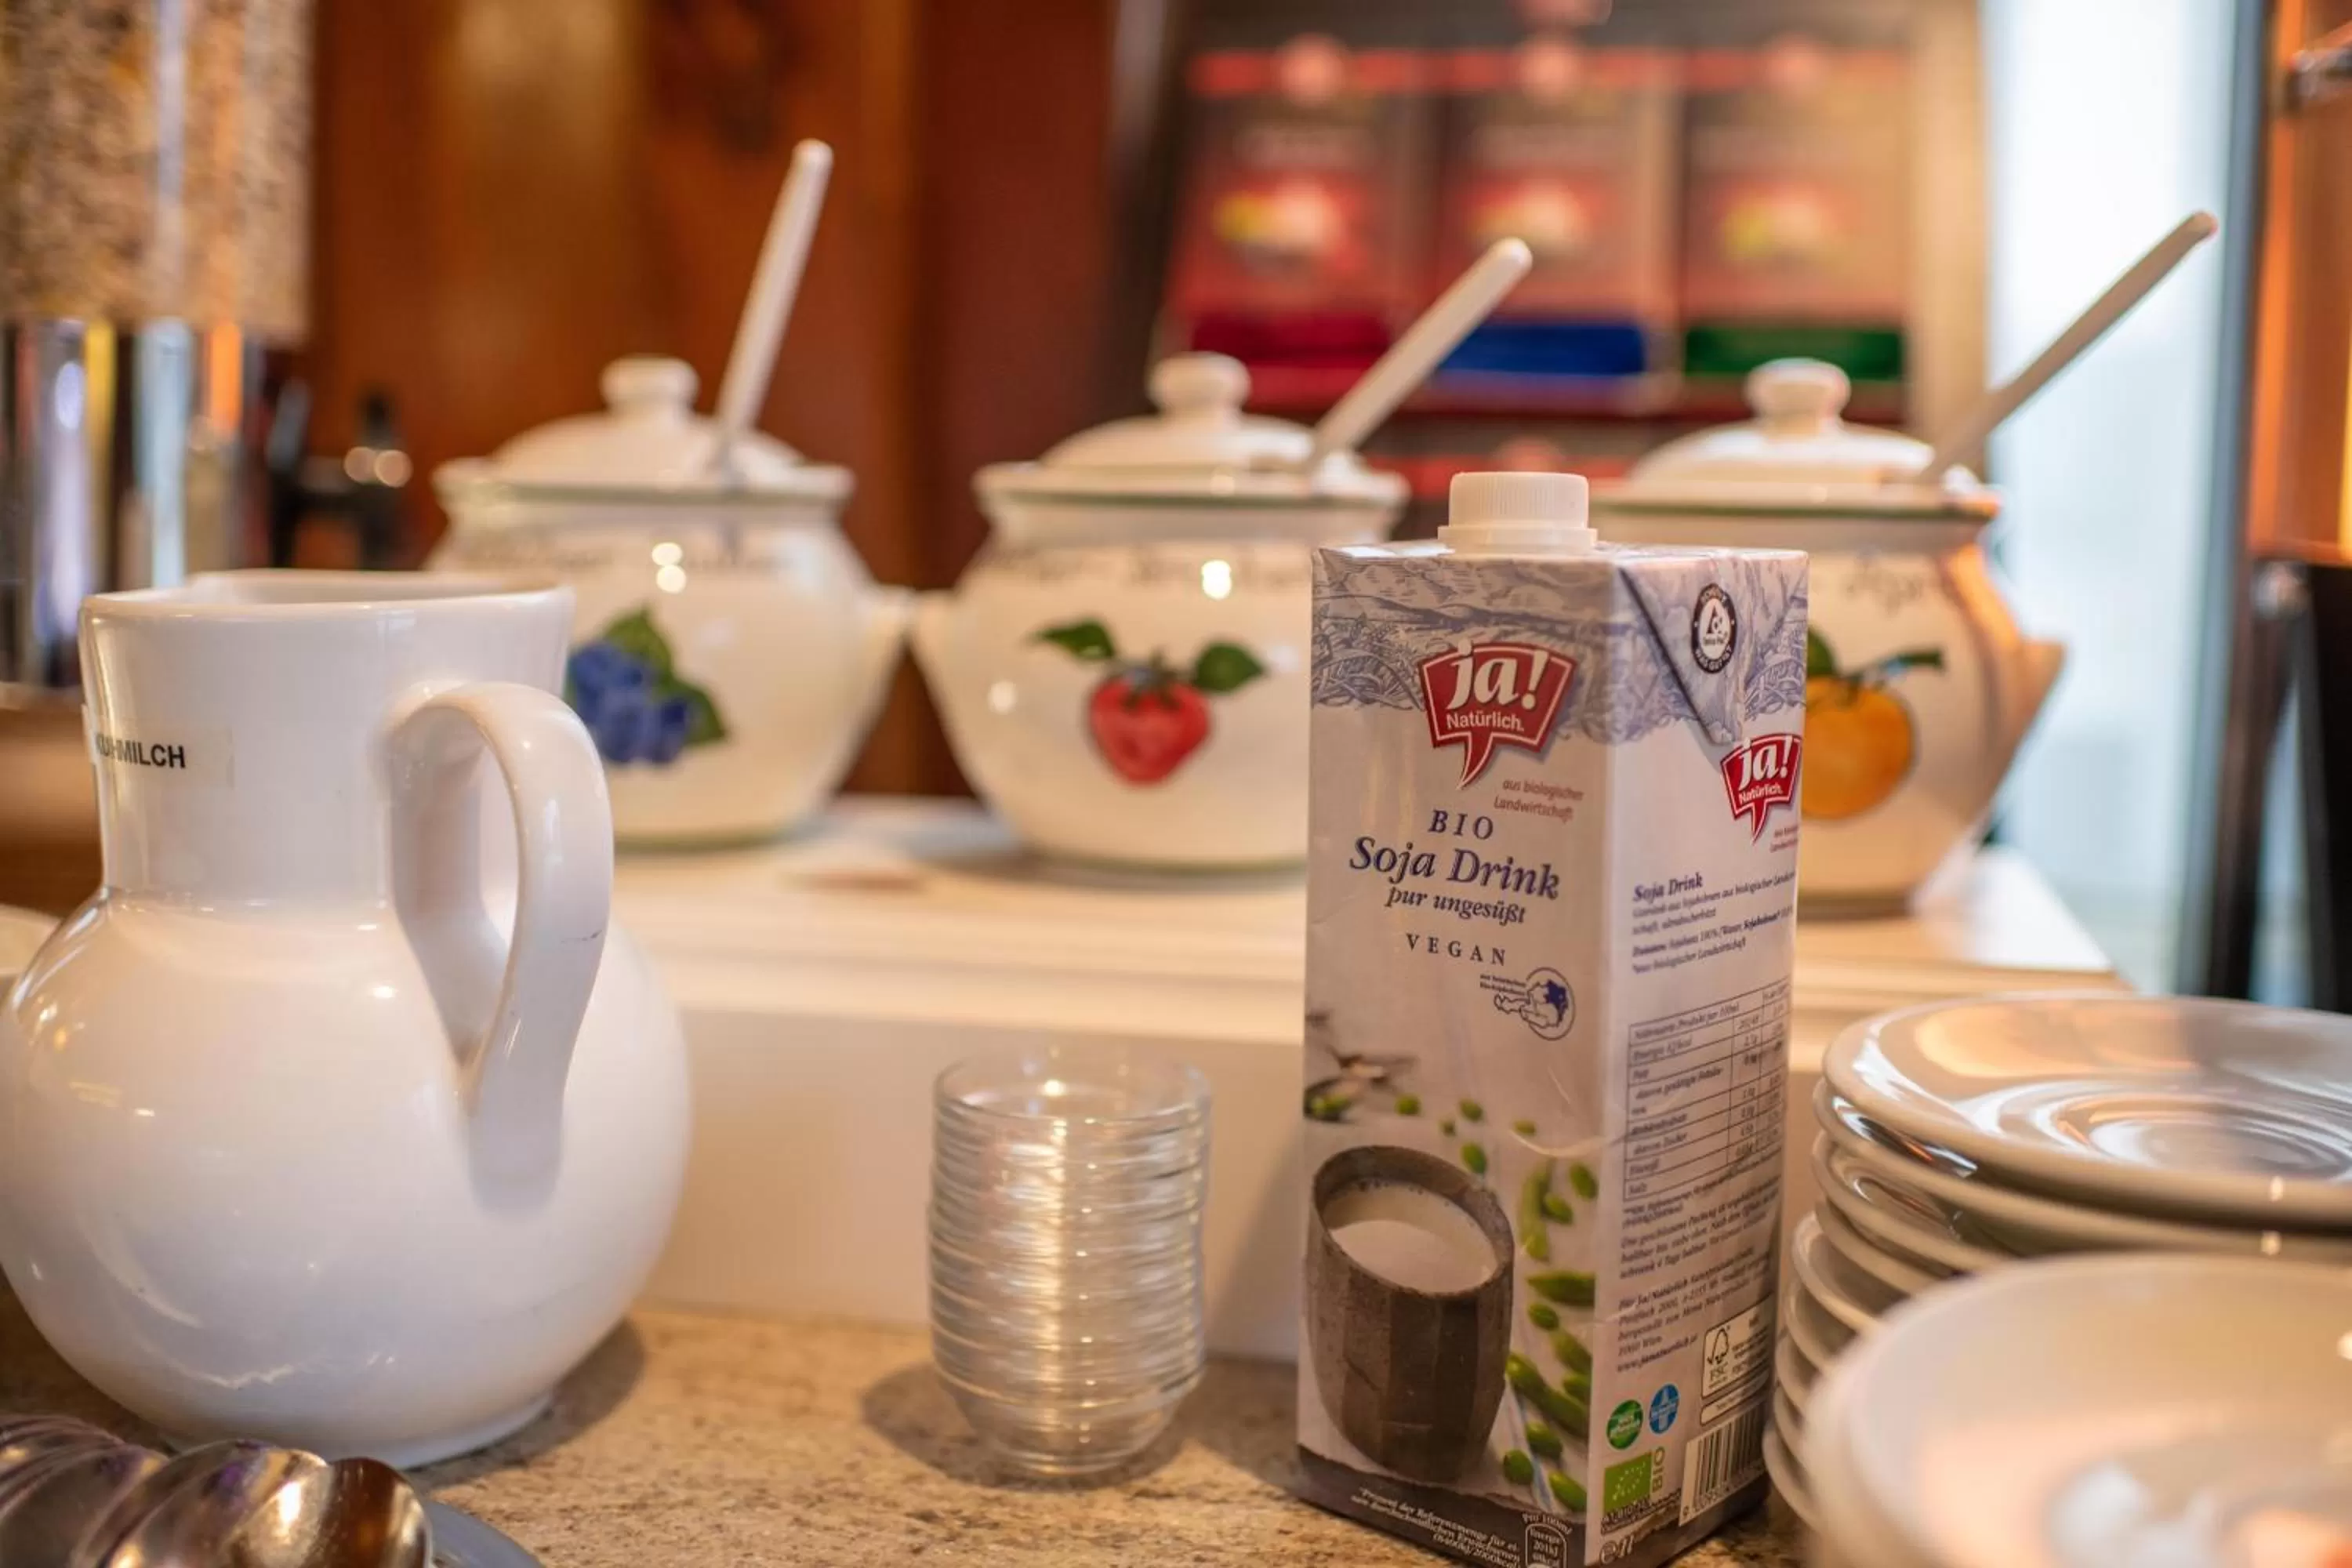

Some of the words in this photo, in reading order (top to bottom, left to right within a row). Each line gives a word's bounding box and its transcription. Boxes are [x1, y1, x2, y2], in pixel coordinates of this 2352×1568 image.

[1445, 638, 1550, 710] ja!
[1446, 710, 1525, 733] Natürlich.
[1738, 735, 1793, 791] ja!
[1428, 809, 1494, 840] BIO
[1348, 836, 1436, 884] Soja
[1446, 848, 1560, 900] Drink
[1385, 886, 1428, 908] pur
[1433, 893, 1526, 926] ungesüßt
[1632, 883, 1664, 904] Soja
[1668, 872, 1704, 896] Drink
[1405, 932, 1507, 967] VEGAN
